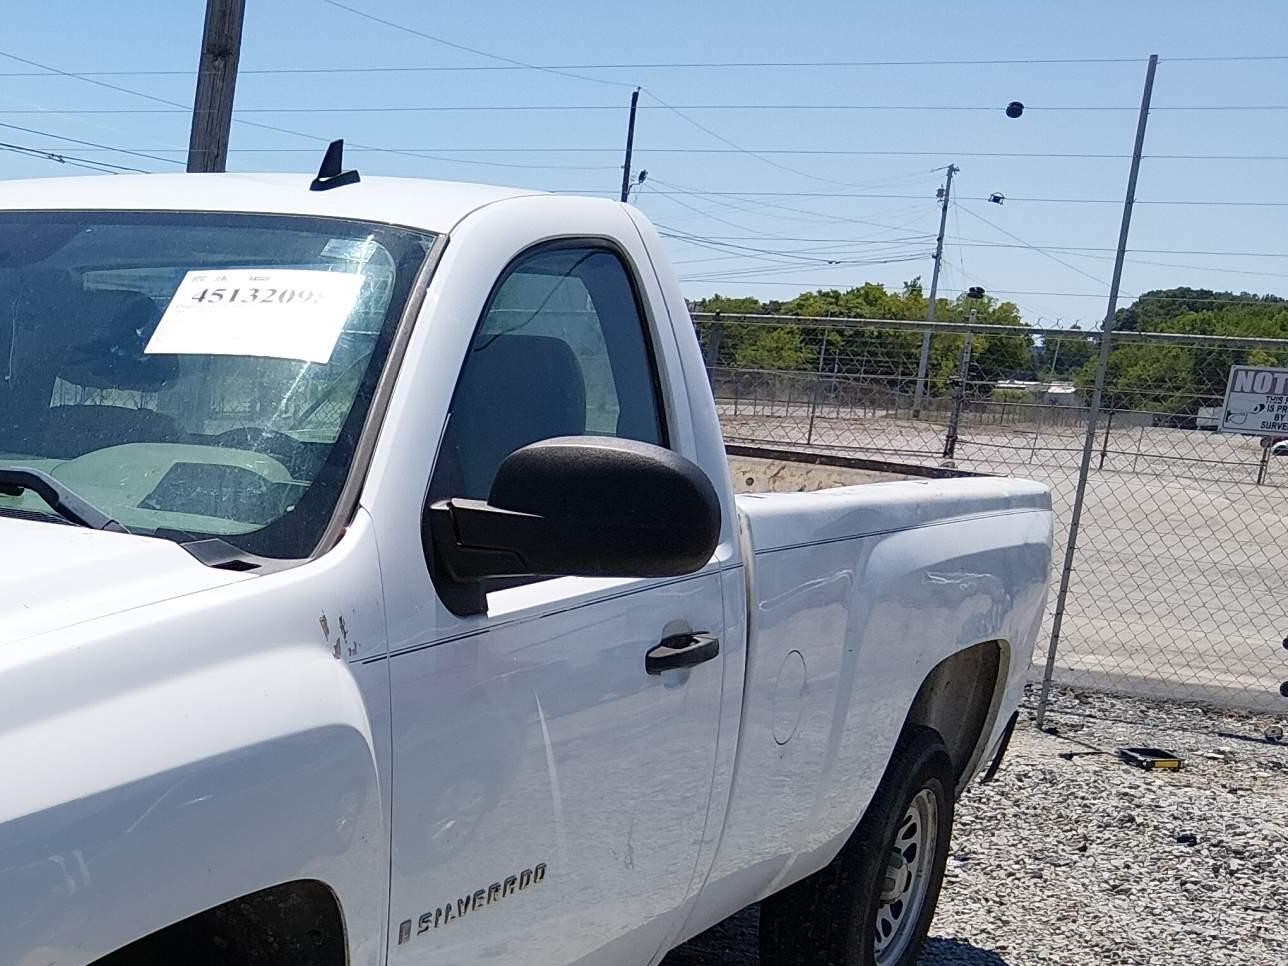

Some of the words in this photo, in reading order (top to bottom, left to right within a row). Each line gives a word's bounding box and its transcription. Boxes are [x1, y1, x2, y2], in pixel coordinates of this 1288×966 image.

[1265, 395, 1283, 404] THIS
[1274, 413, 1285, 421] BY
[417, 862, 547, 936] SILVERADO
